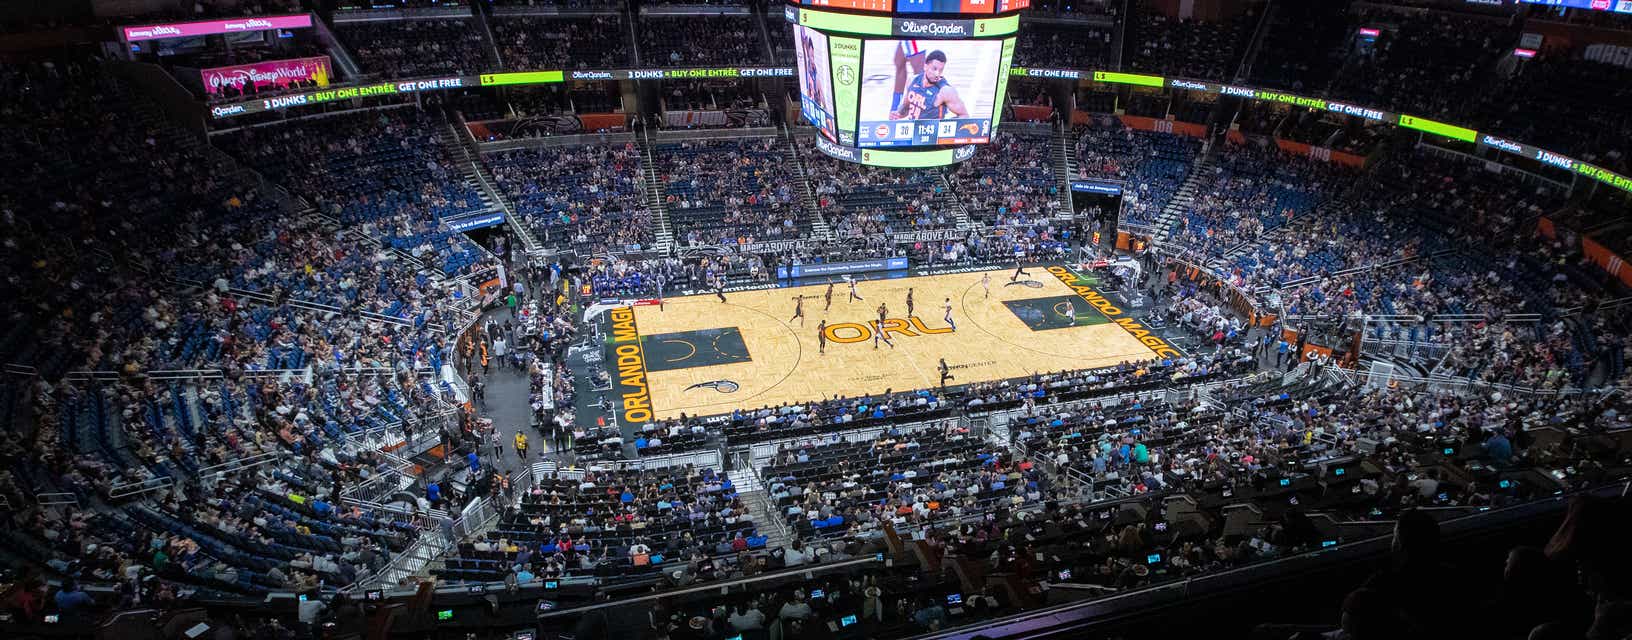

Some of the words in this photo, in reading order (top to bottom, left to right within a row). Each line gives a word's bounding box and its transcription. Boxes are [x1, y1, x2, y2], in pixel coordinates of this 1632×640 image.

[901, 21, 927, 33] Olive
[277, 66, 307, 78] World
[628, 71, 634, 79] 3
[690, 70, 706, 78] ONE
[740, 69, 755, 77] GET
[1029, 69, 1043, 77] GET
[1044, 69, 1060, 78] ONE
[1061, 70, 1079, 79] FREE
[264, 99, 271, 109] 3
[272, 95, 306, 108] DUNKS
[316, 91, 337, 102] BUY
[338, 88, 358, 100] ONE
[399, 82, 417, 92] GET
[418, 80, 438, 90] ONE
[439, 78, 462, 88] FREE
[1227, 86, 1254, 96] DUNKS
[1261, 92, 1278, 101] BUY
[1279, 94, 1296, 104] ONE
[1328, 103, 1343, 112] GET
[1344, 105, 1363, 116] ONE
[1363, 109, 1383, 120] FREE
[1536, 151, 1543, 160] 3
[1543, 153, 1572, 169] DUNKS
[1579, 163, 1597, 177] BUY
[1597, 170, 1614, 183] ONE
[611, 306, 637, 342] MAGI
[1047, 265, 1122, 316] ORLANDO
[1115, 317, 1181, 359] MAGIC
[824, 316, 953, 344] ORL
[616, 345, 651, 423] ORLANDO
